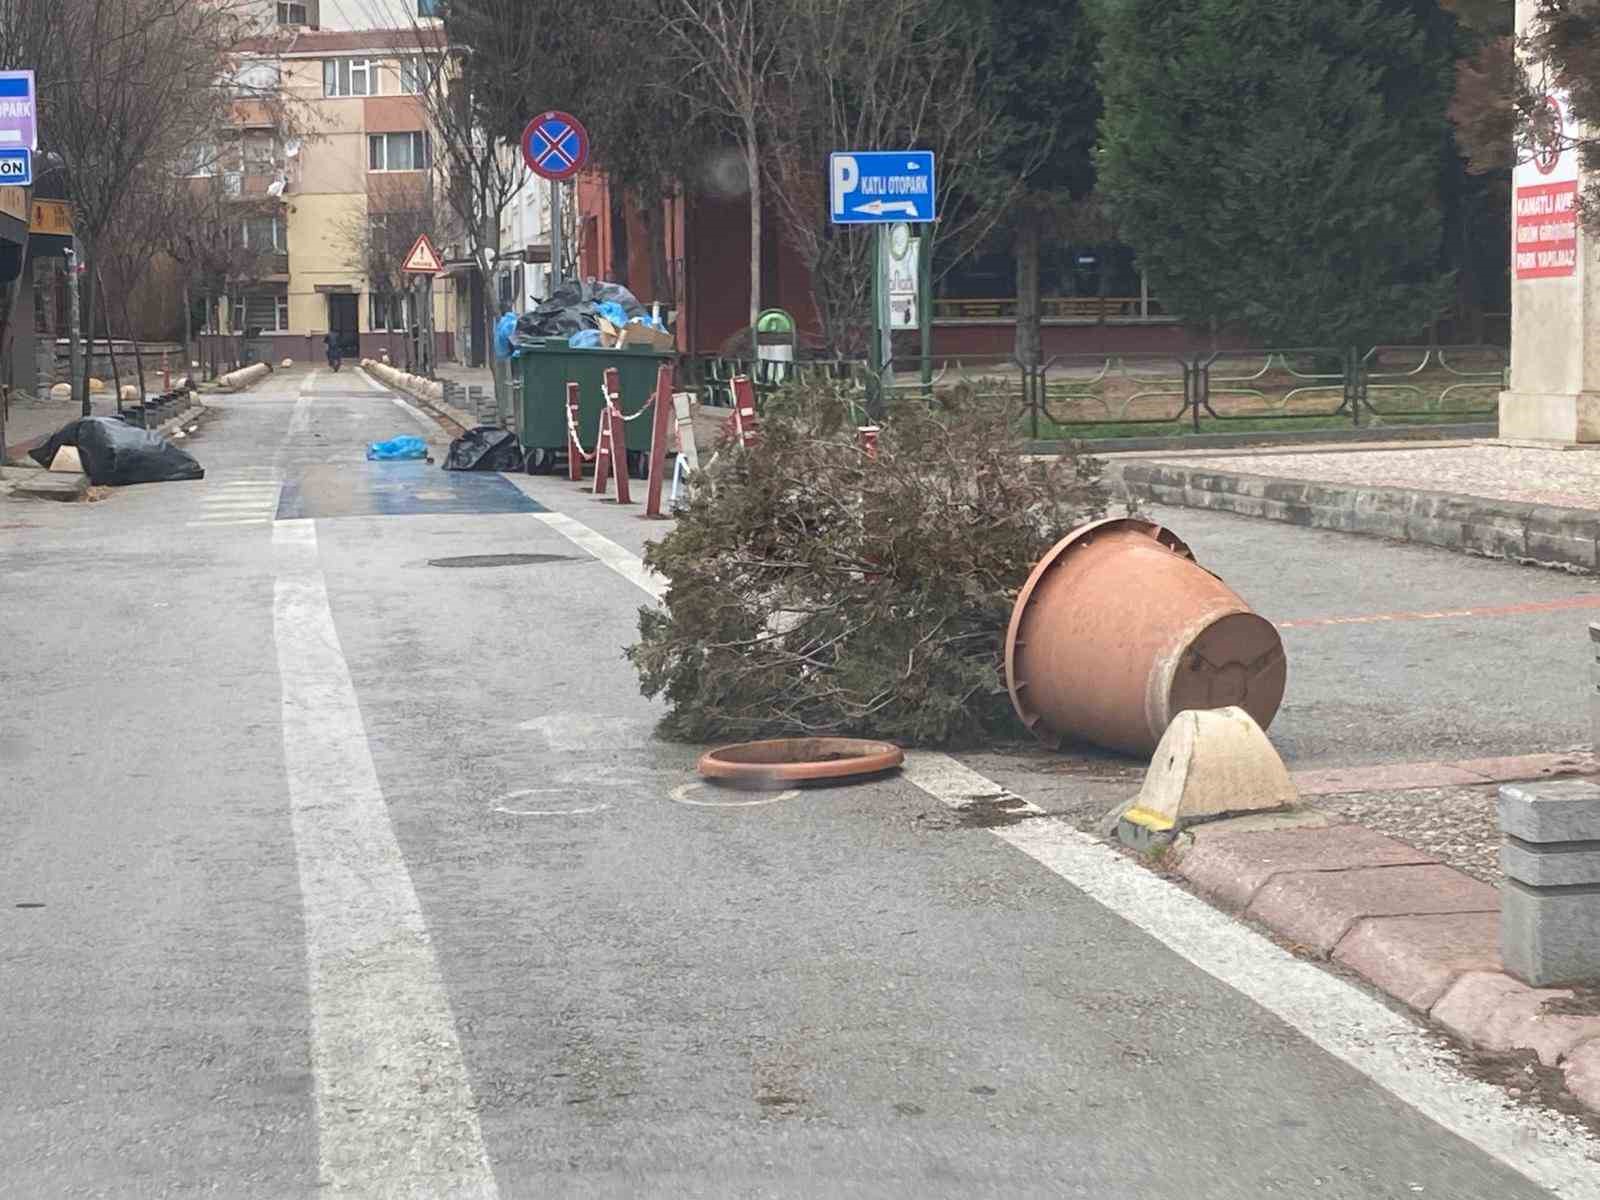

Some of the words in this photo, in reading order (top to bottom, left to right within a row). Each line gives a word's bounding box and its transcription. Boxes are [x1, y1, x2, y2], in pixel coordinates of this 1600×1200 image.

[0, 102, 32, 118] PARK
[833, 156, 859, 215] P
[861, 175, 887, 195] KATLI
[888, 175, 928, 194] OTOPARK
[1517, 251, 1536, 270] PARK
[1537, 248, 1575, 268] YAPILMAZ
